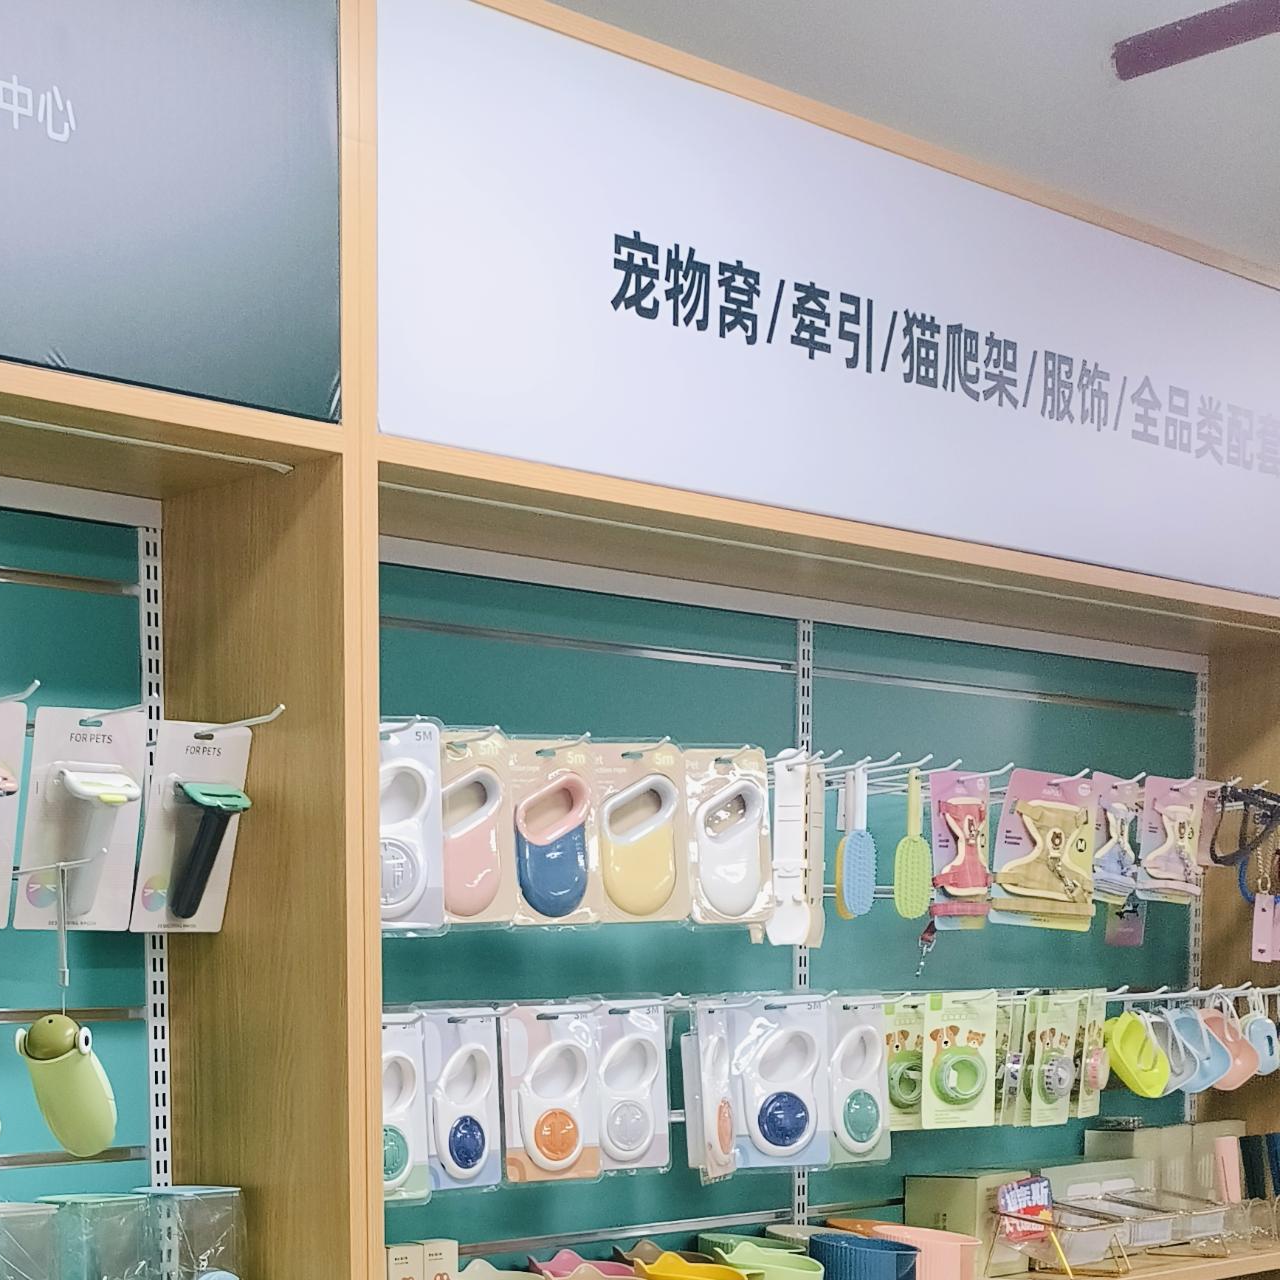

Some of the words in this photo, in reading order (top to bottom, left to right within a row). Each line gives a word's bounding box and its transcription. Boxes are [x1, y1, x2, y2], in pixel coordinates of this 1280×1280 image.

[70, 732, 88, 744] FOR
[89, 733, 113, 745] PETS
[185, 745, 201, 756] FOR
[202, 746, 222, 757] PETS
[567, 751, 586, 764] 5m
[654, 753, 675, 766] 5m
